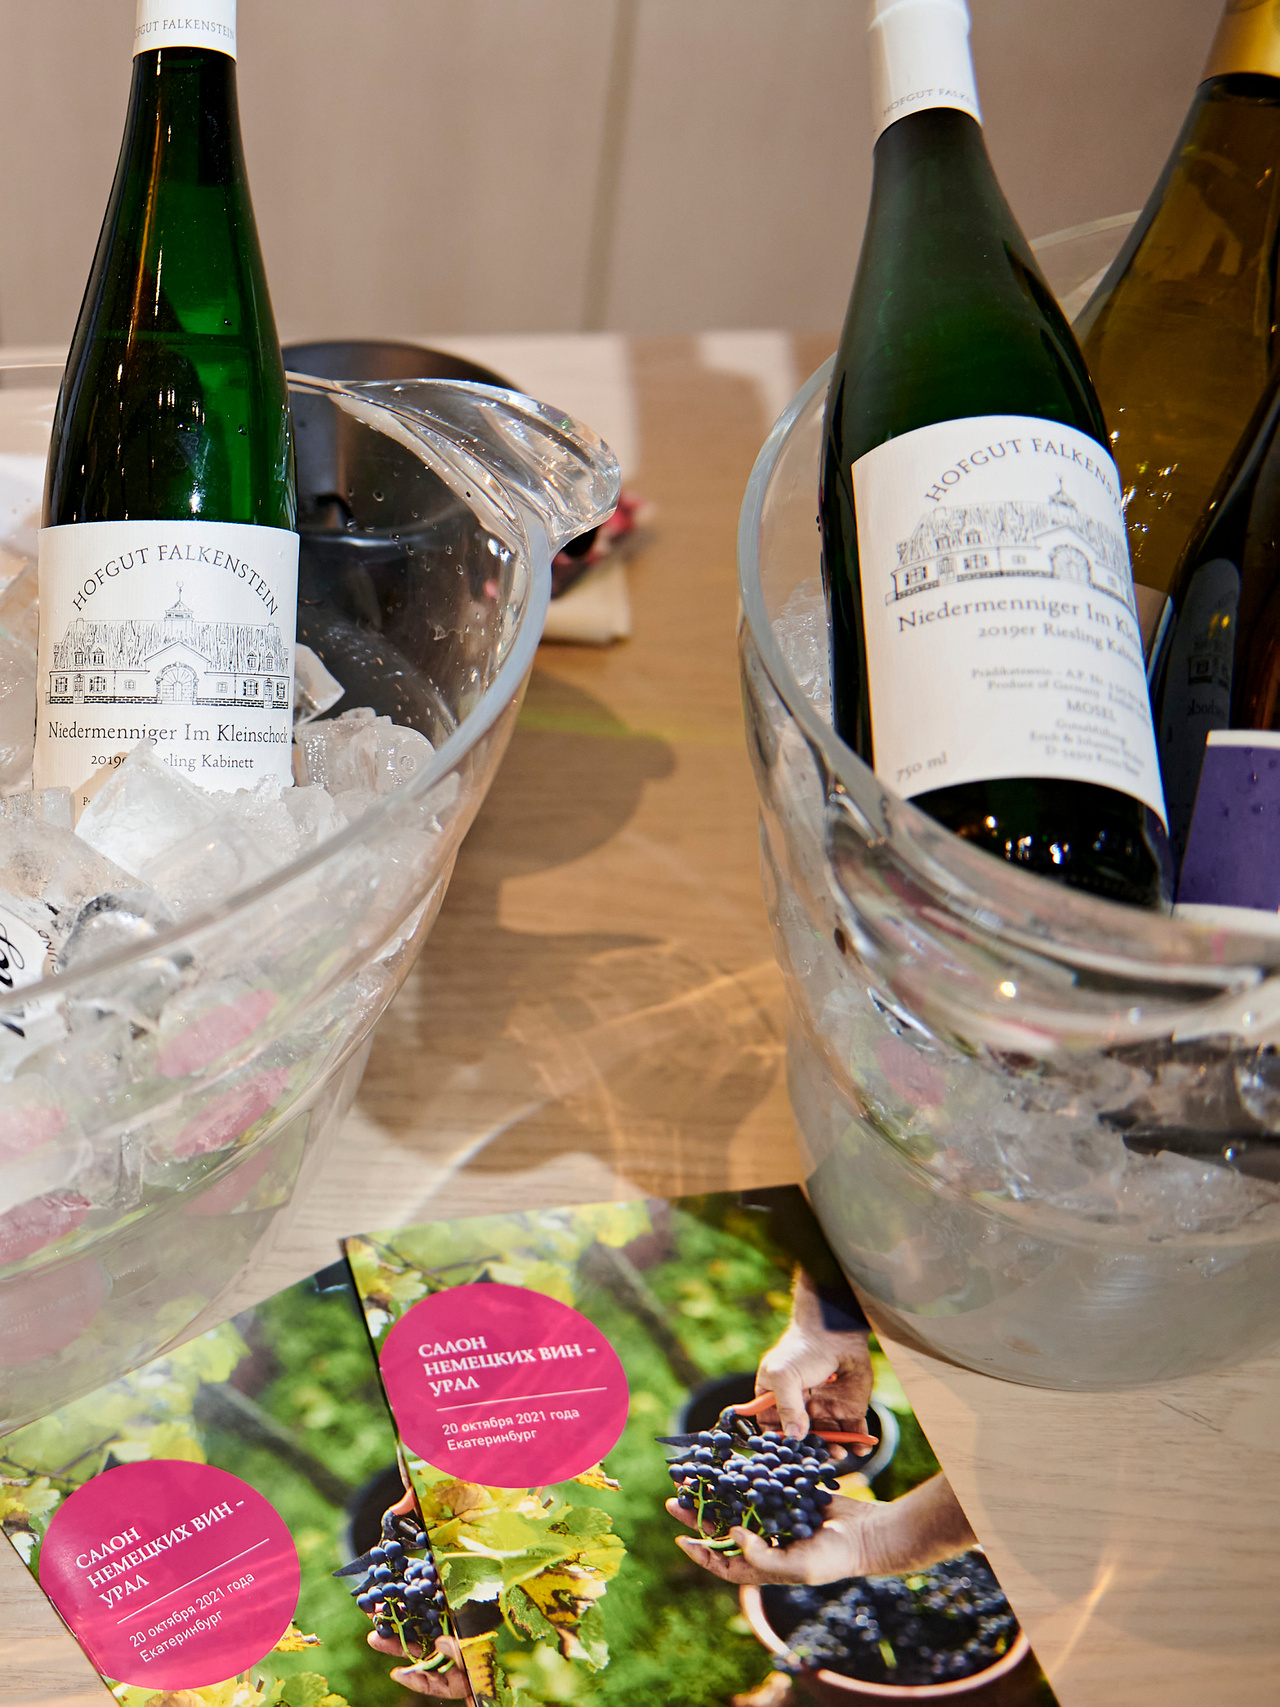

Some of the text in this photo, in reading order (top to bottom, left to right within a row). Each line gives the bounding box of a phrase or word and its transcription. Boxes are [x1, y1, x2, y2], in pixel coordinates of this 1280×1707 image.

[162, 18, 235, 40] FALKENSTEIN
[924, 437, 1120, 506] HOFGUT FALKENST
[72, 544, 279, 617] HOFGUT FALKENSTEIN
[897, 596, 1080, 633] Niedermenniger
[1086, 602, 1111, 628] Im
[977, 623, 1036, 639] 2019er
[48, 720, 289, 746] Niedermenniger Im Kleinschock
[201, 753, 255, 769] Kabinett
[926, 750, 948, 769] ml
[418, 1335, 488, 1358] САЛОН
[423, 1350, 537, 1377] НЕМЕЦКИХ
[538, 1343, 583, 1361] ВИН
[428, 1375, 481, 1397] УРАЛ
[441, 1407, 581, 1436] 20 октября 2021 года
[446, 1428, 538, 1452] Екатеринбург
[75, 1526, 142, 1570] САЛОН
[86, 1523, 194, 1589] НЕМЕЦКИХ
[190, 1501, 234, 1532] ВИН
[98, 1573, 150, 1609] УРАЛ
[129, 1571, 256, 1648] 20 октября 2021 года
[139, 1610, 224, 1663] Екатеринбург
